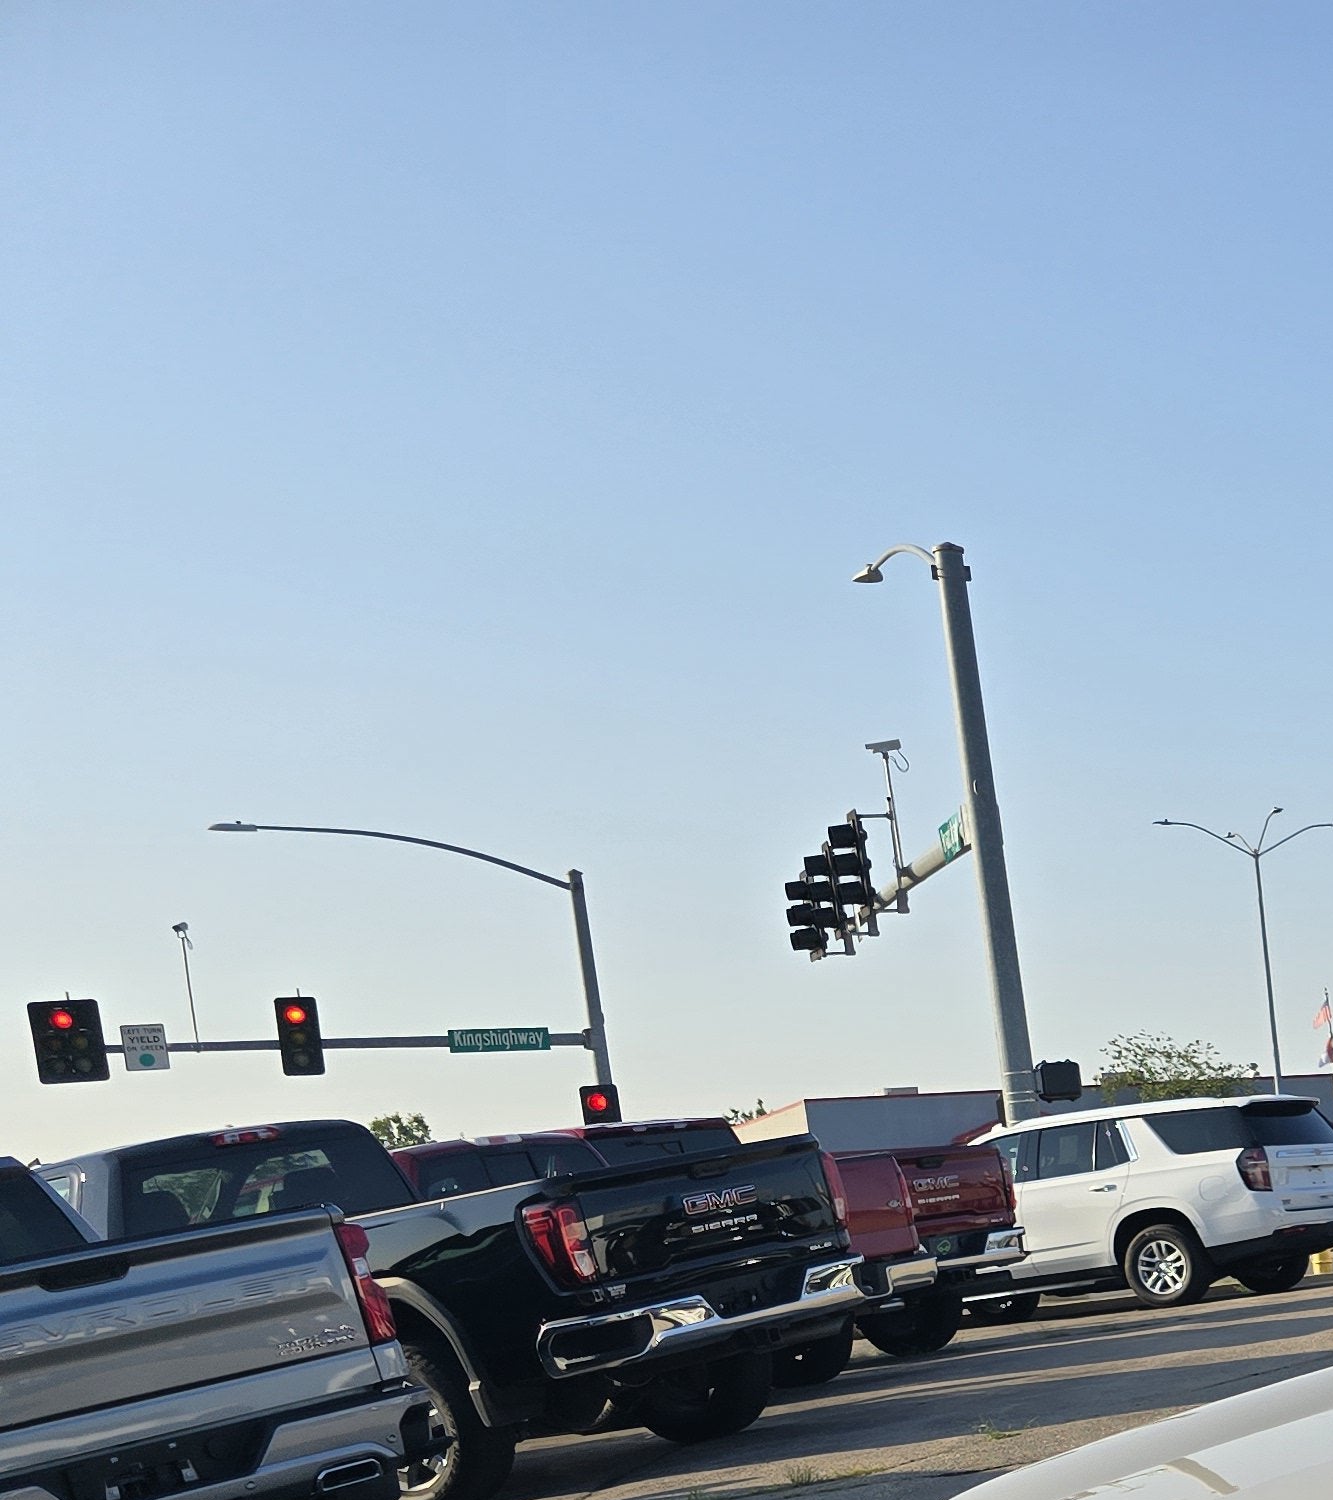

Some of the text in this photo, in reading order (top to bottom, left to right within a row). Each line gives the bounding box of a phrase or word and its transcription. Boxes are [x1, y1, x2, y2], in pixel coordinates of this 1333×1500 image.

[129, 1035, 161, 1043] YIELD
[453, 1030, 544, 1050] Kingshighway
[912, 1174, 960, 1192] GMC
[683, 1184, 758, 1215] GMC
[917, 1194, 960, 1204] SIERRA
[691, 1213, 758, 1234] SIERRA
